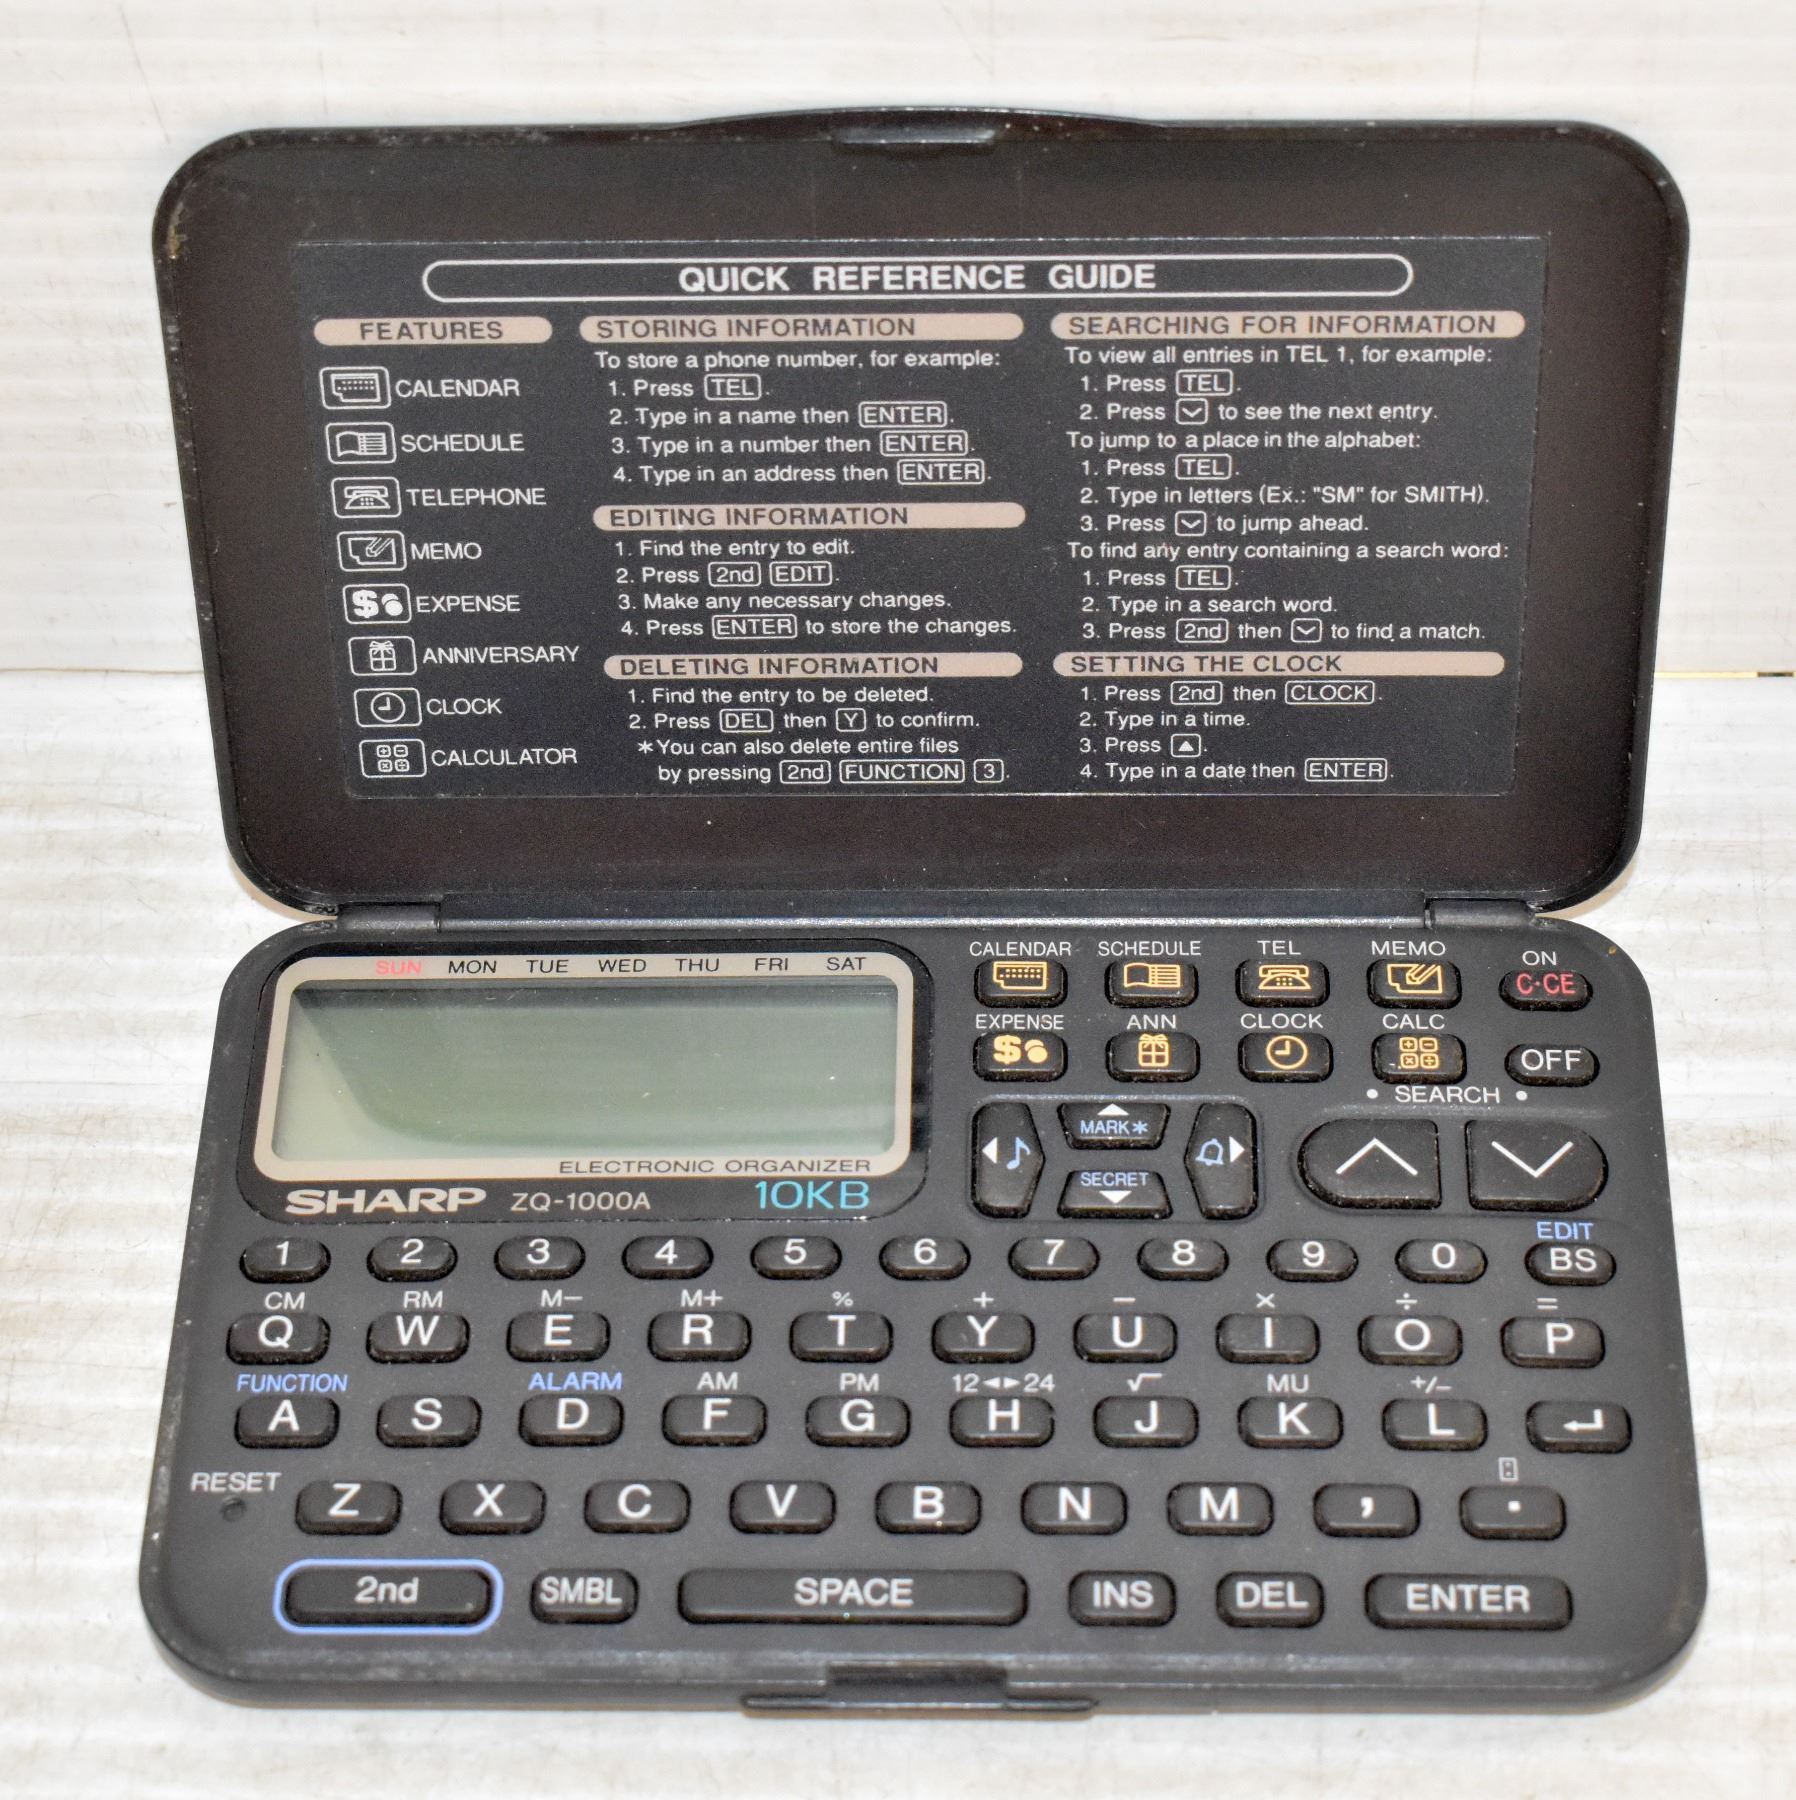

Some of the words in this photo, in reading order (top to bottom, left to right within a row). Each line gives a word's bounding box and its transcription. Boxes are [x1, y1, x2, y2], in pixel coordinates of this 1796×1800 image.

[679, 267, 789, 292] QUICK
[813, 265, 1025, 290] REFERENCE
[1049, 264, 1155, 289] GUIDE
[360, 321, 503, 340] FEATURES
[597, 319, 716, 338] STORING
[728, 318, 914, 337] INFORMATION
[1070, 316, 1229, 335] SEARCHING
[1242, 316, 1296, 334] FOR
[1309, 315, 1495, 333] INFORMATION
[594, 351, 620, 368] To
[628, 353, 678, 368] store
[685, 355, 698, 368] a
[704, 351, 770, 371] phone
[777, 351, 862, 368] number,
[870, 350, 898, 367] for
[905, 350, 999, 369] example:
[1064, 347, 1091, 364] To
[1099, 347, 1146, 363] view
[1153, 346, 1176, 363] all
[1183, 346, 1253, 363] entries
[1261, 346, 1278, 363] in
[1286, 345, 1328, 362] TEL
[1362, 345, 1390, 362] for
[1396, 345, 1491, 366] example:
[395, 379, 519, 397] CALENDAR
[1080, 404, 1097, 420] 2.
[1107, 403, 1165, 420] Press
[1218, 404, 1238, 420] to
[1245, 406, 1282, 420] see
[1289, 403, 1321, 419] the
[1329, 404, 1372, 419] next
[1379, 404, 1437, 423] entry.
[401, 434, 524, 452] SCHEDULE
[1066, 432, 1093, 448] To
[1099, 432, 1149, 452] jump
[1157, 433, 1176, 448] to
[1186, 435, 1198, 448] a
[1203, 431, 1259, 451] place
[1265, 431, 1281, 448] in
[1287, 432, 1319, 448] the
[1325, 431, 1420, 451] alphabet:
[406, 488, 546, 506] TELEPHONE
[610, 508, 715, 526] EDITING
[727, 507, 907, 525] INFORMATION
[411, 542, 482, 559] MEMO
[616, 541, 633, 557] 1.
[640, 540, 683, 556] Find
[690, 540, 722, 556] the
[729, 540, 780, 559] entry
[786, 540, 805, 555] to
[813, 539, 854, 555] edit.
[1067, 542, 1093, 558] To
[1100, 542, 1136, 558] find
[1144, 543, 1180, 561] any
[1187, 543, 1238, 561] entry
[1245, 542, 1349, 561] containing
[1357, 545, 1368, 558] a
[1376, 542, 1443, 558] search
[1451, 543, 1508, 558] word:
[416, 595, 520, 612] EXPENSE
[619, 594, 636, 610] 3.
[644, 593, 698, 609] Make
[706, 597, 741, 612] any
[749, 596, 853, 611] necessary
[860, 592, 950, 611] changes.
[1082, 597, 1099, 611] 2.
[1108, 596, 1157, 616] Type
[1165, 596, 1181, 612] in
[1189, 600, 1201, 612] a
[1208, 597, 1275, 612] search
[1283, 596, 1336, 612] word.
[423, 646, 579, 664] ANNIVERSARY
[1072, 656, 1184, 673] SETTING
[1194, 656, 1243, 672] THE
[1253, 655, 1341, 672] CLOCK
[621, 658, 748, 675] DELETING
[759, 657, 937, 674] INFORMATION
[629, 689, 644, 703] 1.
[653, 688, 694, 703] Find
[701, 688, 732, 703] the
[739, 689, 789, 706] entry
[797, 689, 815, 702] to
[823, 688, 847, 703] be
[855, 687, 933, 702] deleted.
[427, 698, 502, 715] CLOCK
[1080, 712, 1096, 726] 2.
[1105, 711, 1153, 730] Type
[1161, 711, 1177, 726] in
[1185, 714, 1196, 726] a
[1203, 712, 1250, 727] time.
[431, 748, 577, 766] CALCULATOR
[970, 942, 1071, 956] CALENDAR
[1098, 941, 1201, 956] SCHEDULE
[1257, 941, 1301, 955] TEL
[1372, 941, 1445, 956] MEMO
[376, 960, 421, 975] SUN
[449, 960, 496, 974] MON
[527, 960, 568, 973] TUE
[599, 959, 646, 972] WED
[675, 959, 719, 972] THU
[755, 958, 788, 971] FRI
[827, 957, 866, 970] SAT
[1522, 951, 1556, 965] ON
[976, 1014, 1064, 1030] EXPENSE
[1127, 1014, 1176, 1029] ANN
[1241, 1013, 1323, 1029] CLOCK
[1383, 1014, 1444, 1029] CALC
[1521, 1049, 1581, 1071] OFF
[1395, 1086, 1500, 1104] SEARCH
[560, 1160, 714, 1173] ELECTRONIC
[725, 1160, 870, 1172] ORGANIZER
[1081, 1172, 1148, 1186] SECRET
[286, 1188, 486, 1215] SHARP
[511, 1192, 650, 1211] ZQ-1000A
[756, 1181, 869, 1209] 10KB
[1537, 1221, 1593, 1240] EDIT
[277, 1241, 289, 1265] 1
[401, 1239, 423, 1264] 2
[527, 1239, 550, 1265] 3
[655, 1240, 678, 1264] 4
[784, 1239, 806, 1264] 5
[914, 1239, 936, 1264] 6
[1044, 1239, 1064, 1265] 7
[1172, 1240, 1195, 1266] 8
[1302, 1241, 1325, 1267] 9
[1432, 1243, 1456, 1269] 0
[1551, 1248, 1596, 1272] BS
[265, 1292, 305, 1310] CM
[403, 1291, 443, 1308] RM
[259, 1315, 293, 1348] Q
[397, 1316, 439, 1345] W
[544, 1315, 573, 1346] E
[683, 1314, 713, 1345] R
[828, 1315, 856, 1346] T
[237, 1374, 348, 1393] FUNCTION
[529, 1372, 622, 1391] ALARM
[697, 1372, 737, 1390] AM
[840, 1373, 879, 1391] PM
[1267, 1374, 1309, 1393] MU
[191, 1472, 281, 1492] RESET
[355, 1576, 419, 1603] 2nd
[541, 1577, 622, 1604] SMBL
[795, 1578, 913, 1606] SPACE
[1094, 1581, 1153, 1608] INS
[1236, 1581, 1308, 1609] DEL
[1407, 1584, 1529, 1612] ENTER
